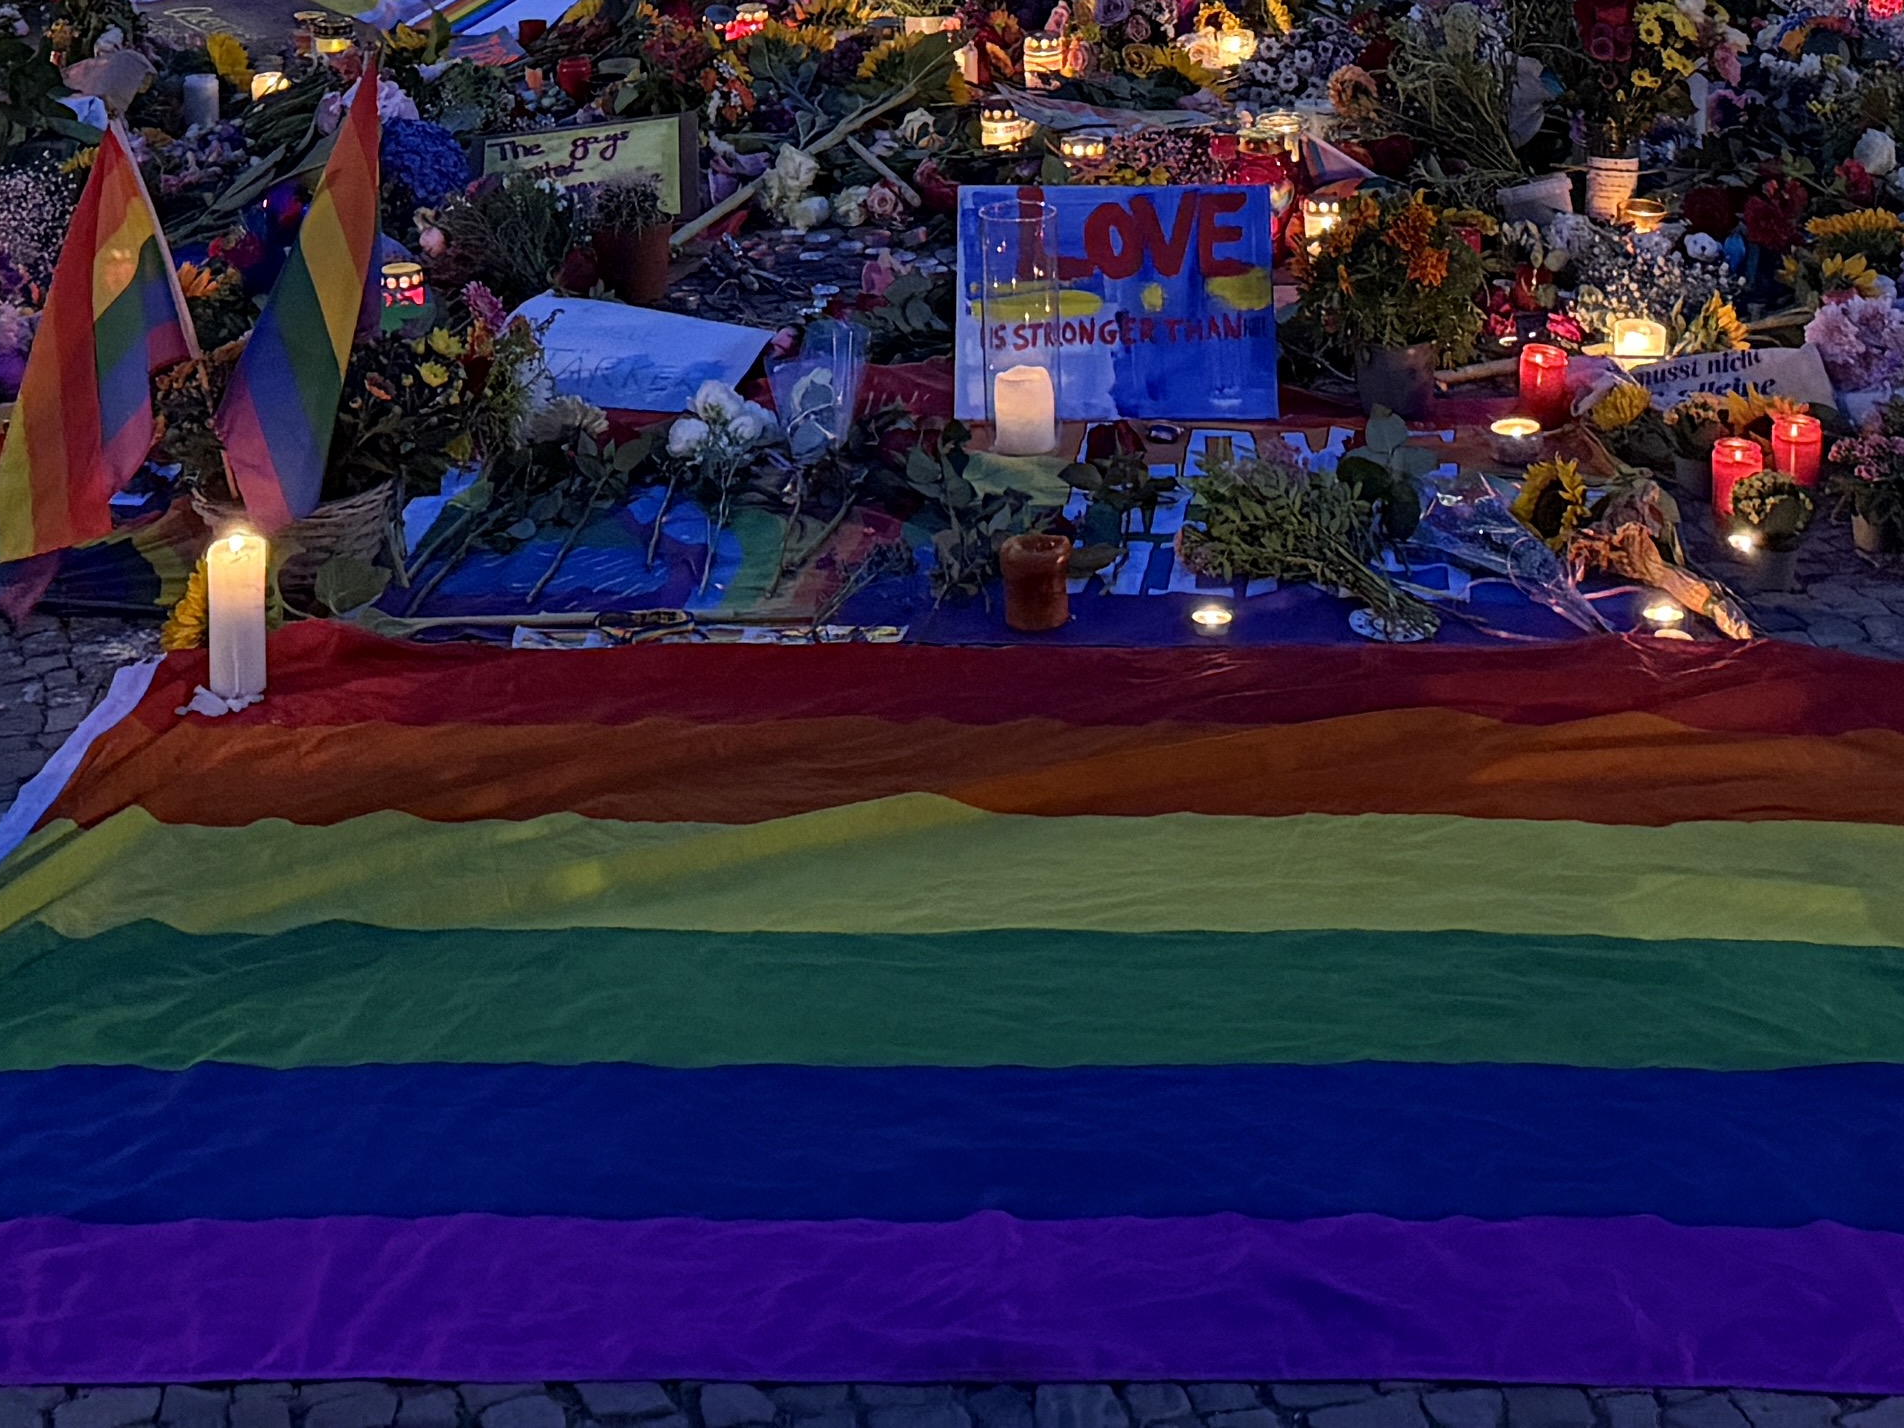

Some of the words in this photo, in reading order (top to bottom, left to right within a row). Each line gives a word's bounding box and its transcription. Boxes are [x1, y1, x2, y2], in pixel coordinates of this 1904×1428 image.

[486, 140, 546, 162] The
[569, 129, 631, 162] gays
[1016, 186, 1252, 280] LOVE
[1012, 316, 1156, 352] STRONGER
[1163, 311, 1243, 344] THAN
